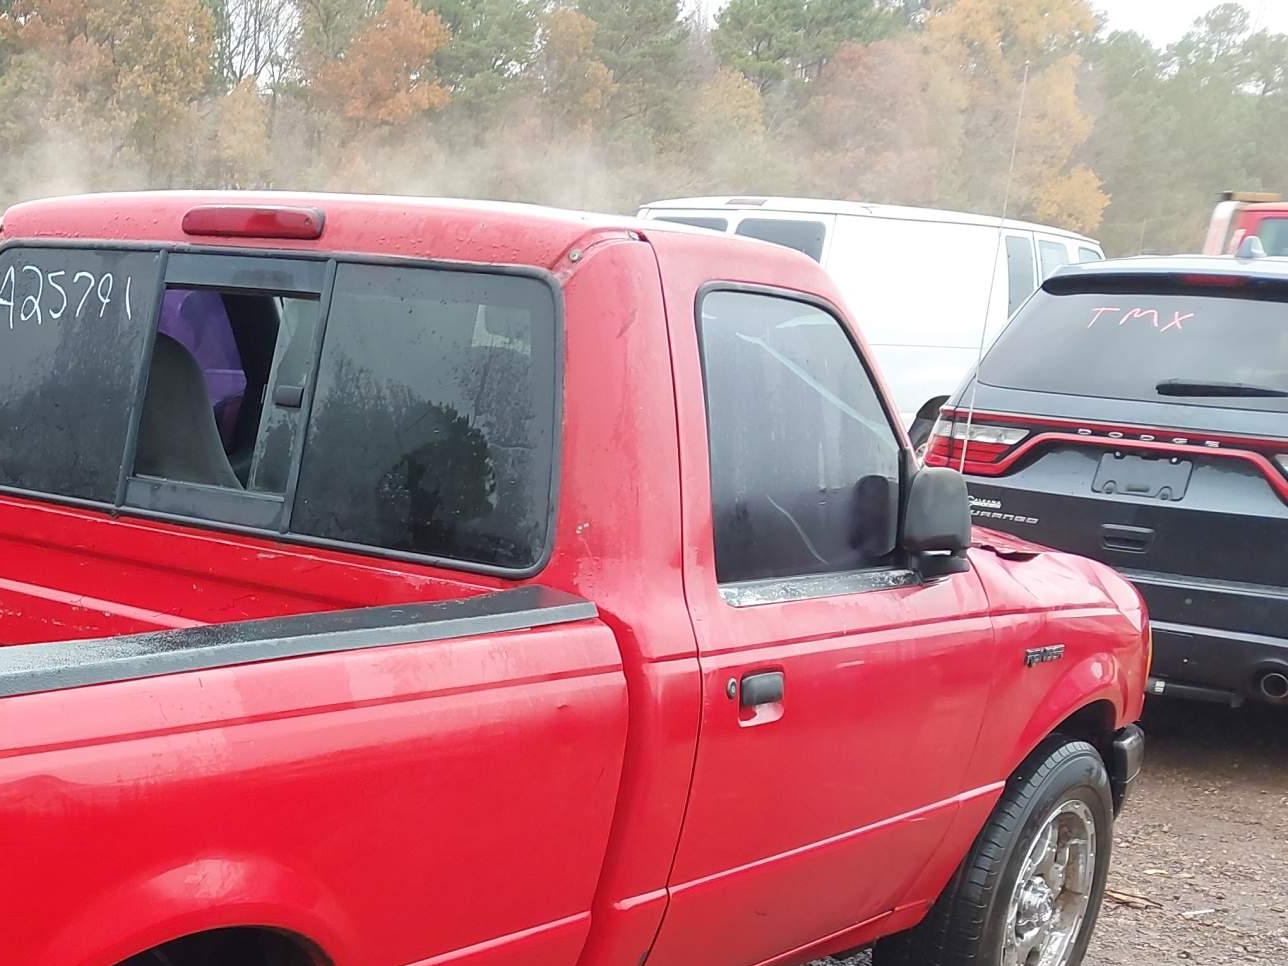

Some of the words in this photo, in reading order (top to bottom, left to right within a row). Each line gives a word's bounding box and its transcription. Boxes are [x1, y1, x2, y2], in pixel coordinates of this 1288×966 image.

[1087, 306, 1195, 333] TMX
[1077, 428, 1221, 448] DODGE
[970, 509, 1040, 525] URANGO
